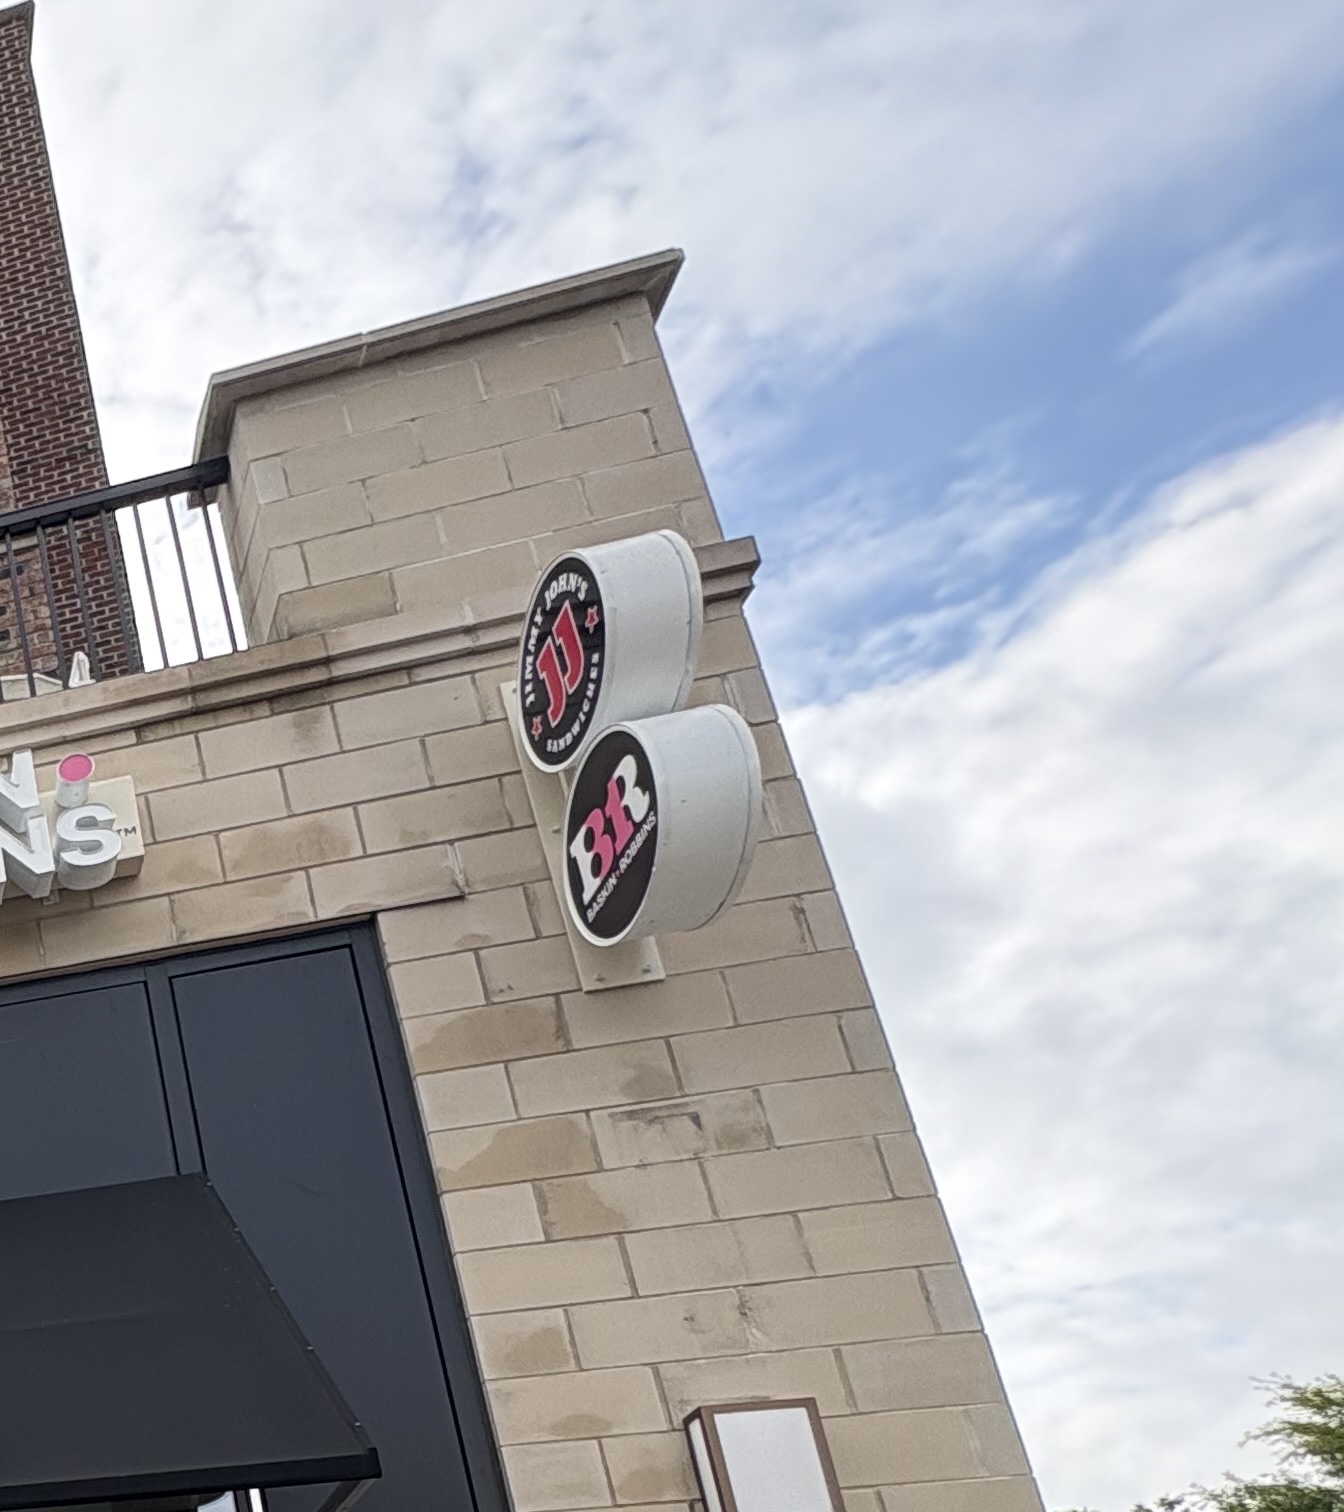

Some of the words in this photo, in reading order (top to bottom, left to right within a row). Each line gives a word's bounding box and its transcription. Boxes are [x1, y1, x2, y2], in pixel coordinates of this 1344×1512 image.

[544, 572, 589, 611] JOHN'S
[570, 755, 650, 901] BR
[587, 872, 617, 924] BASKIN
[618, 811, 657, 875] ROBBINS
